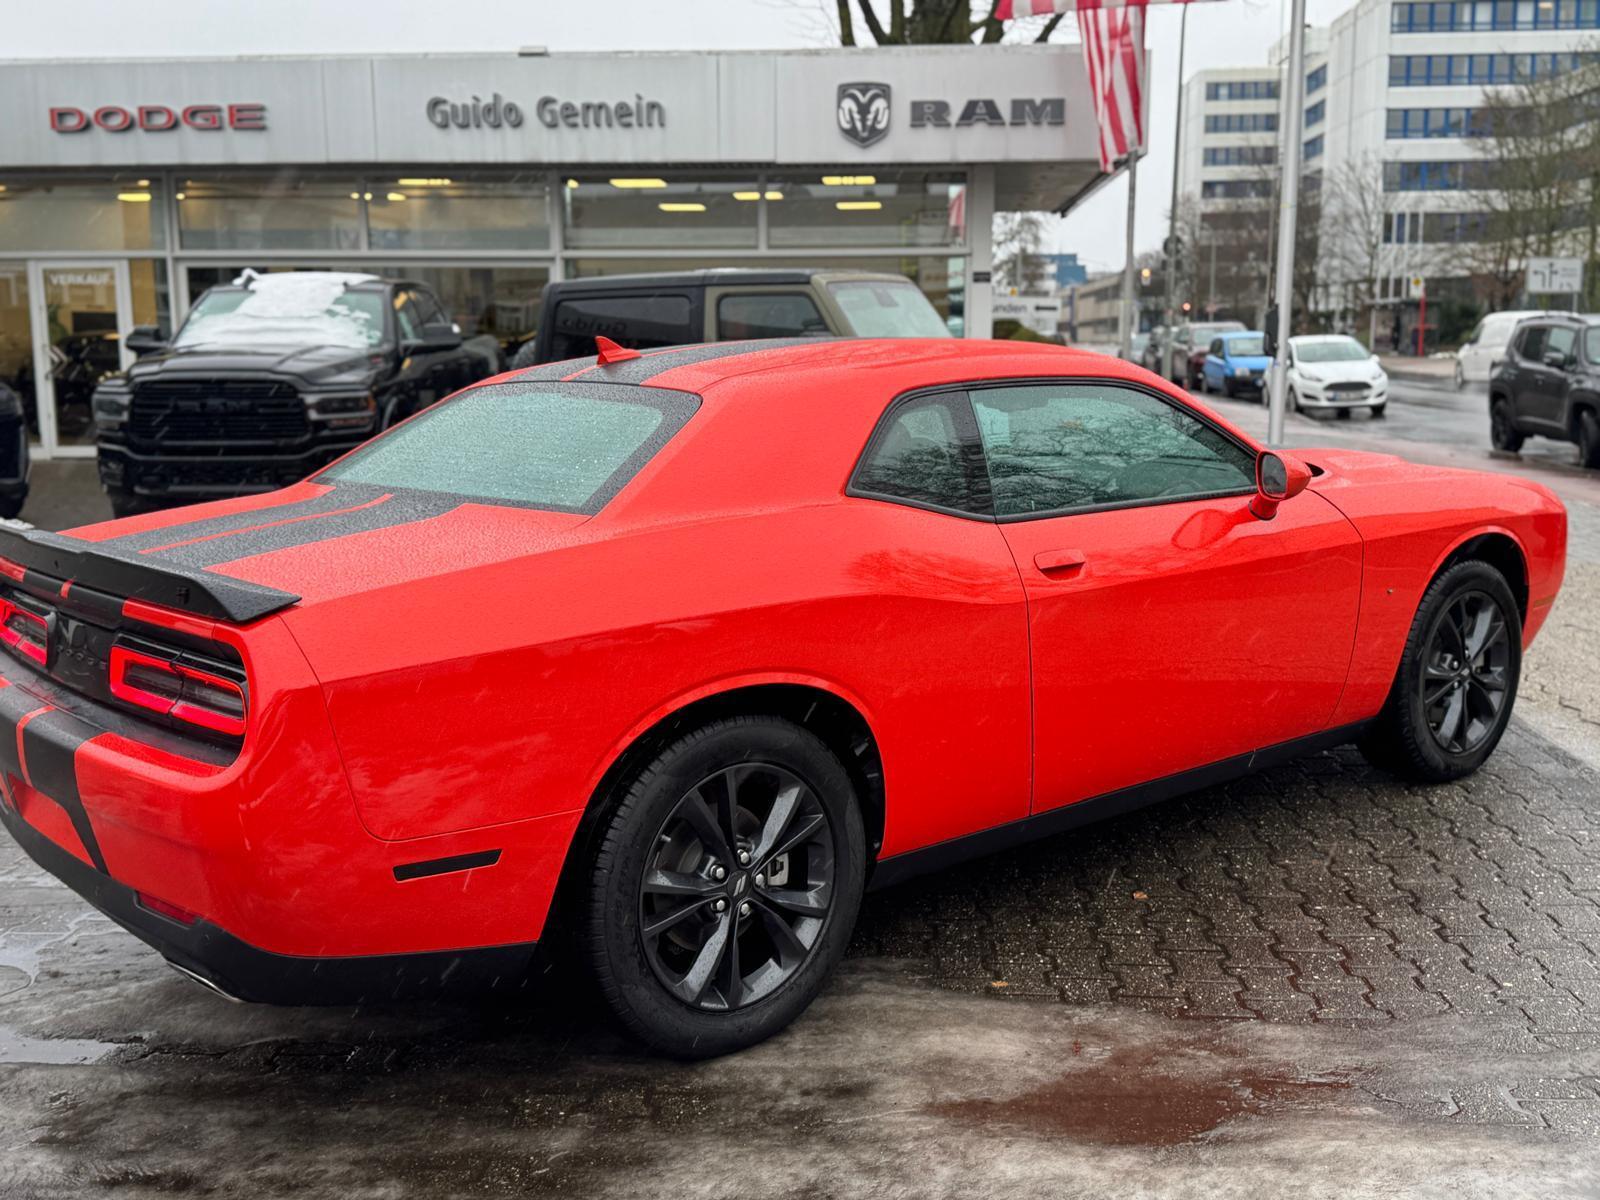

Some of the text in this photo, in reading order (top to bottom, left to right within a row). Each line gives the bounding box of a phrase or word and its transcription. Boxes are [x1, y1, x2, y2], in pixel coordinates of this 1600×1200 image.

[49, 103, 266, 132] DODGE
[426, 93, 666, 129] Guido Gemein
[910, 98, 1066, 128] RAM
[48, 272, 112, 285] VERKAUF
